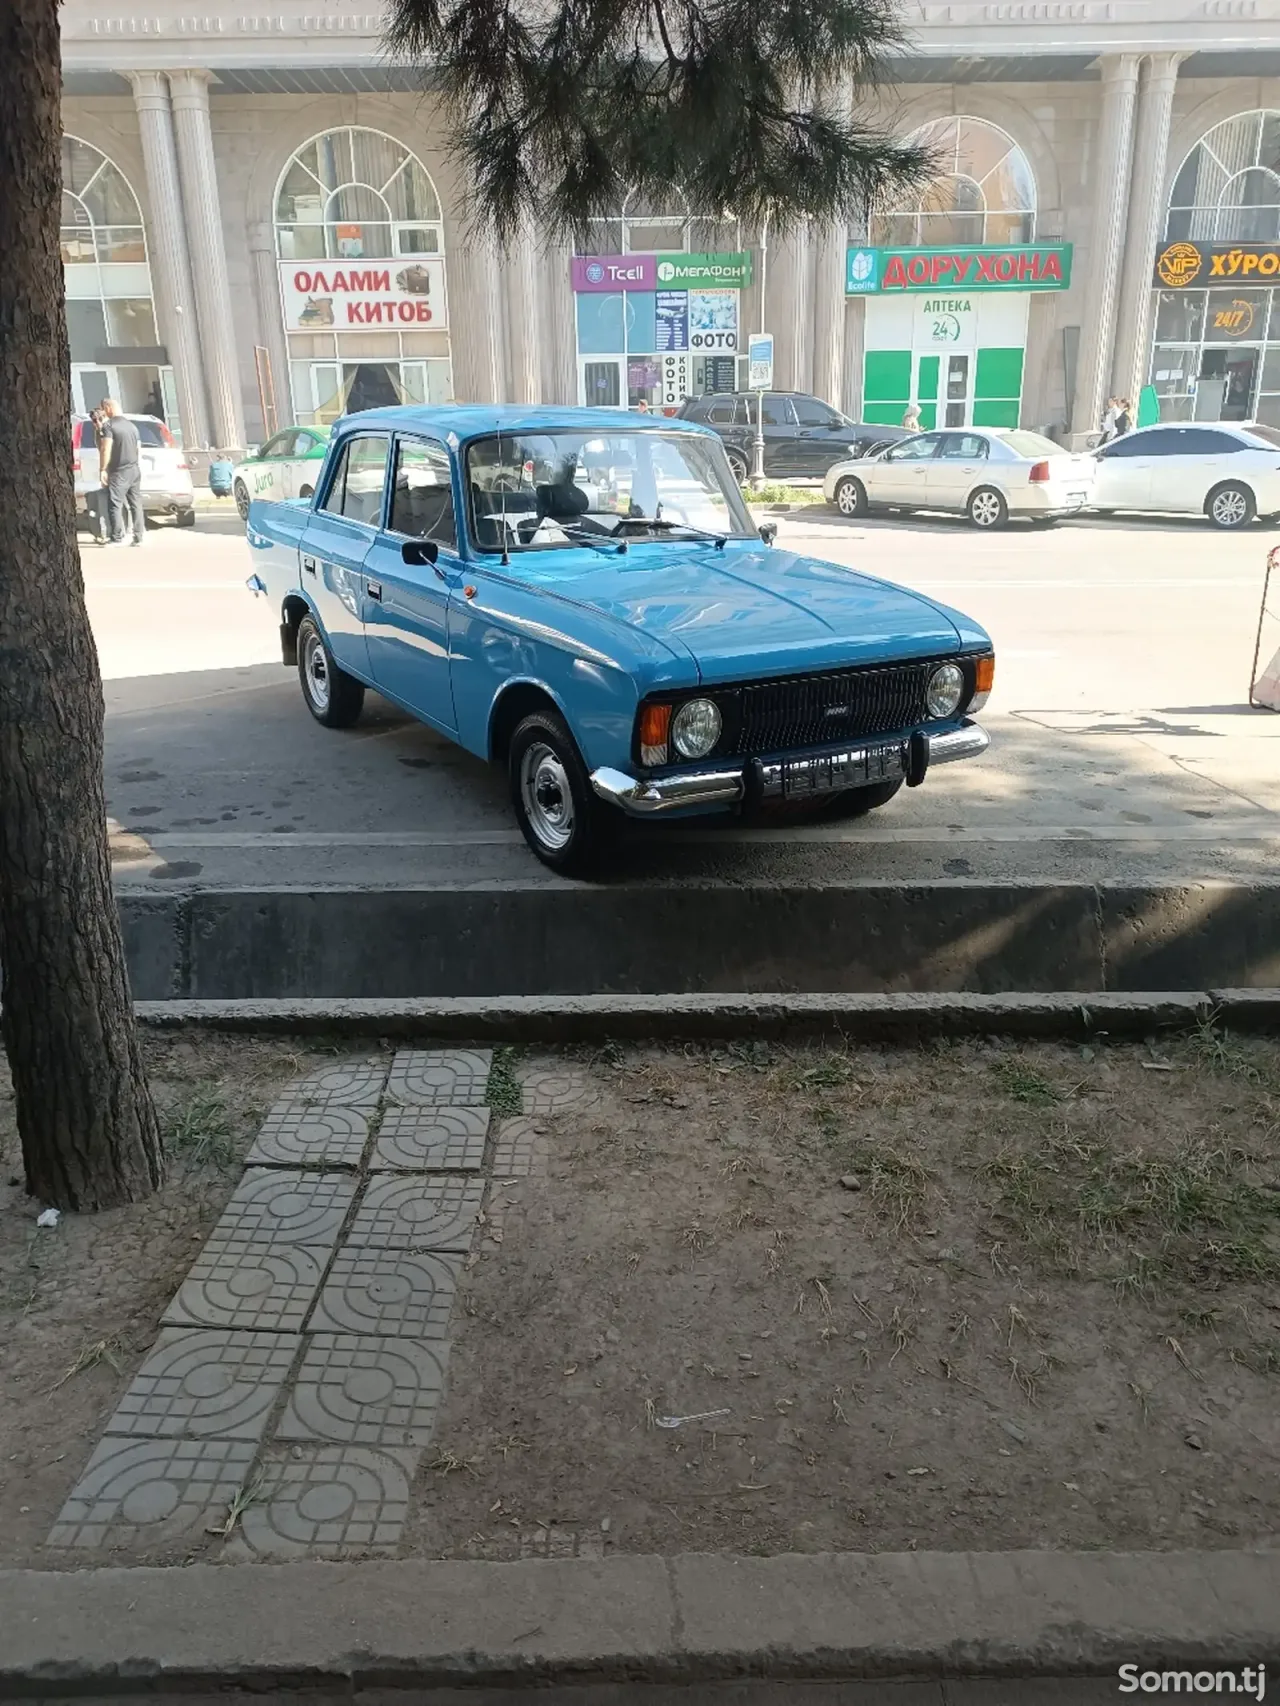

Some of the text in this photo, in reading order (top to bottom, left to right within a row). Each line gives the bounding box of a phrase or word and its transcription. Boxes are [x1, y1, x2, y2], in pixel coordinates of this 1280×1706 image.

[882, 252, 1063, 289] ДОРУХОНА
[1163, 257, 1198, 275] VIP
[1208, 249, 1280, 276] ХӮРО
[294, 270, 391, 293] ОЛАМИ
[607, 265, 644, 281] Tcell
[347, 301, 432, 324] КИТОБ
[923, 300, 972, 313] АПТЕКА
[932, 320, 948, 336] 24
[1213, 310, 1245, 328] 24/7
[691, 333, 736, 348] ФОТО
[665, 356, 676, 403] ФОТО
[678, 356, 687, 402] КОПИЯ
